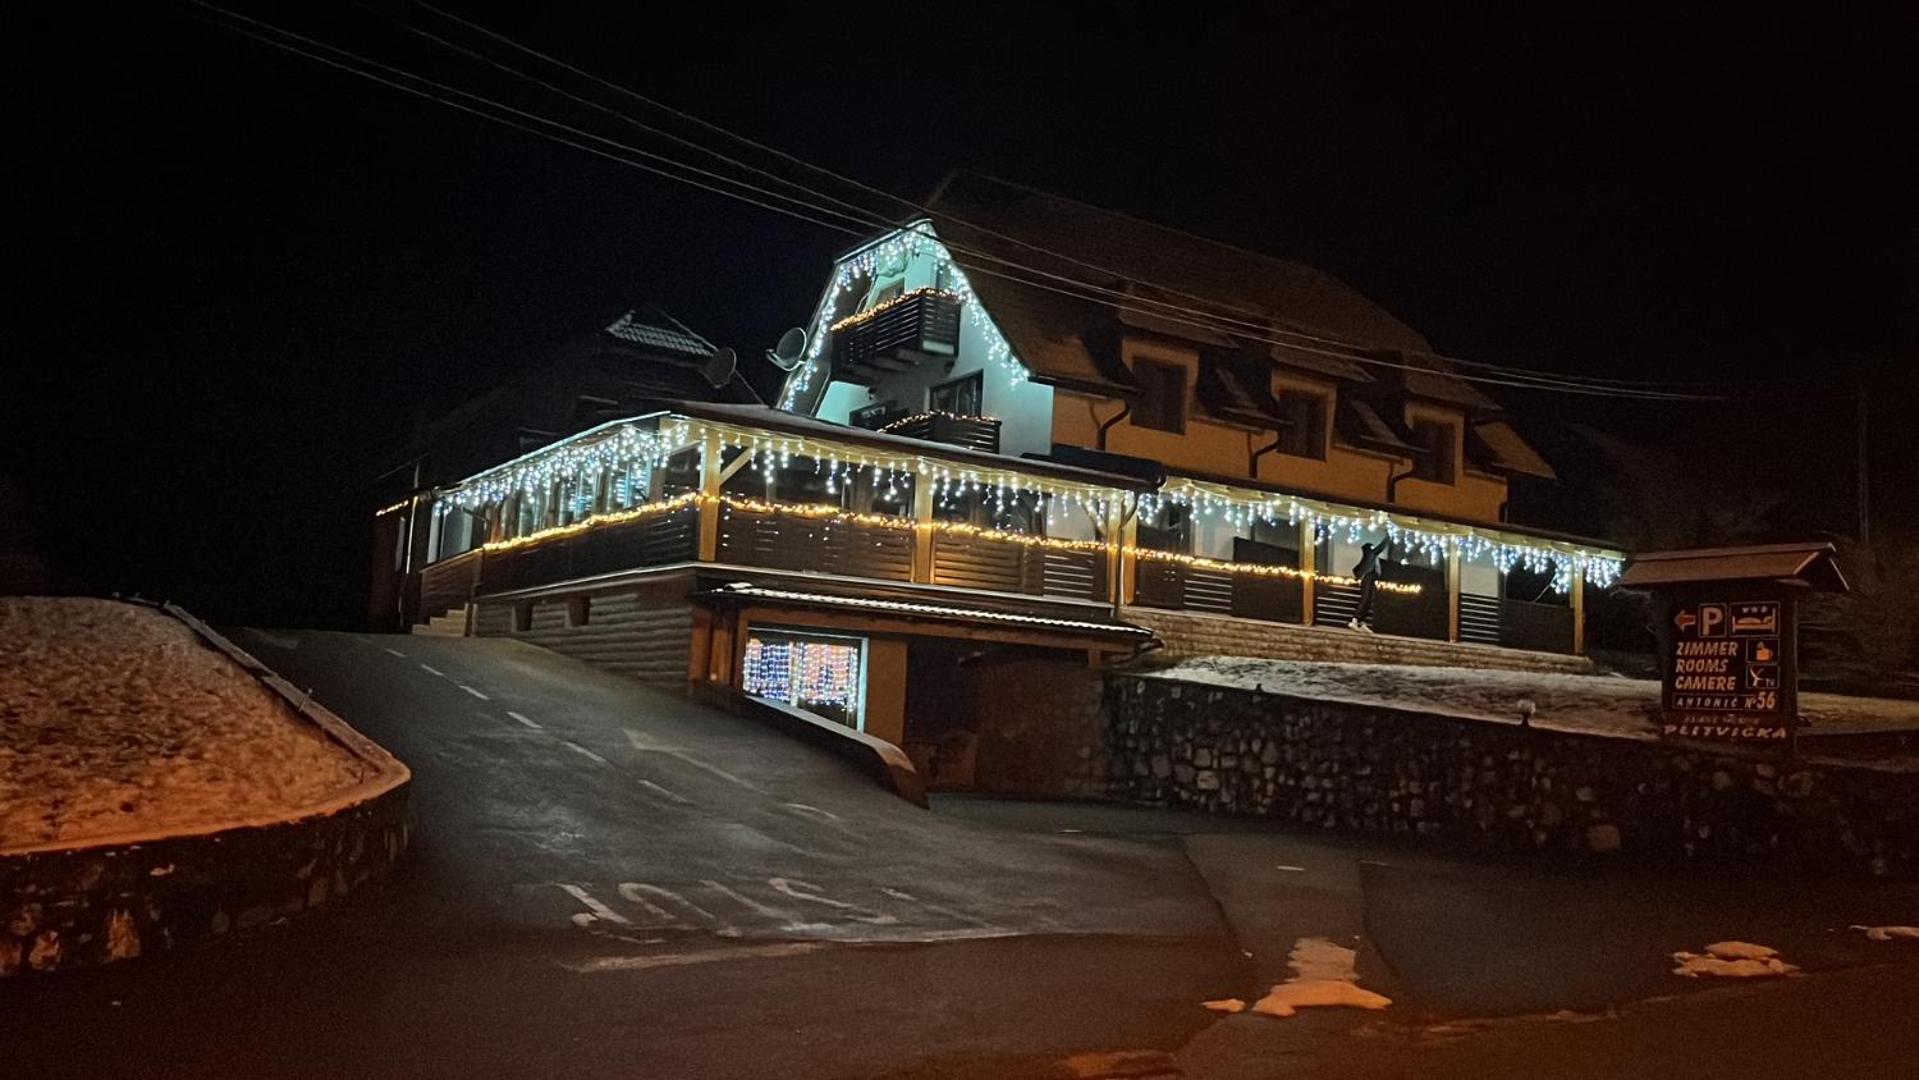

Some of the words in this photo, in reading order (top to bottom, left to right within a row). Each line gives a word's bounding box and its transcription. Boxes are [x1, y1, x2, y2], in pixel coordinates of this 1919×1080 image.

[1702, 606, 1724, 636] P
[1676, 641, 1739, 656] ZIMMER
[1675, 659, 1729, 673] ROOMS
[1675, 676, 1737, 691] CAMERE
